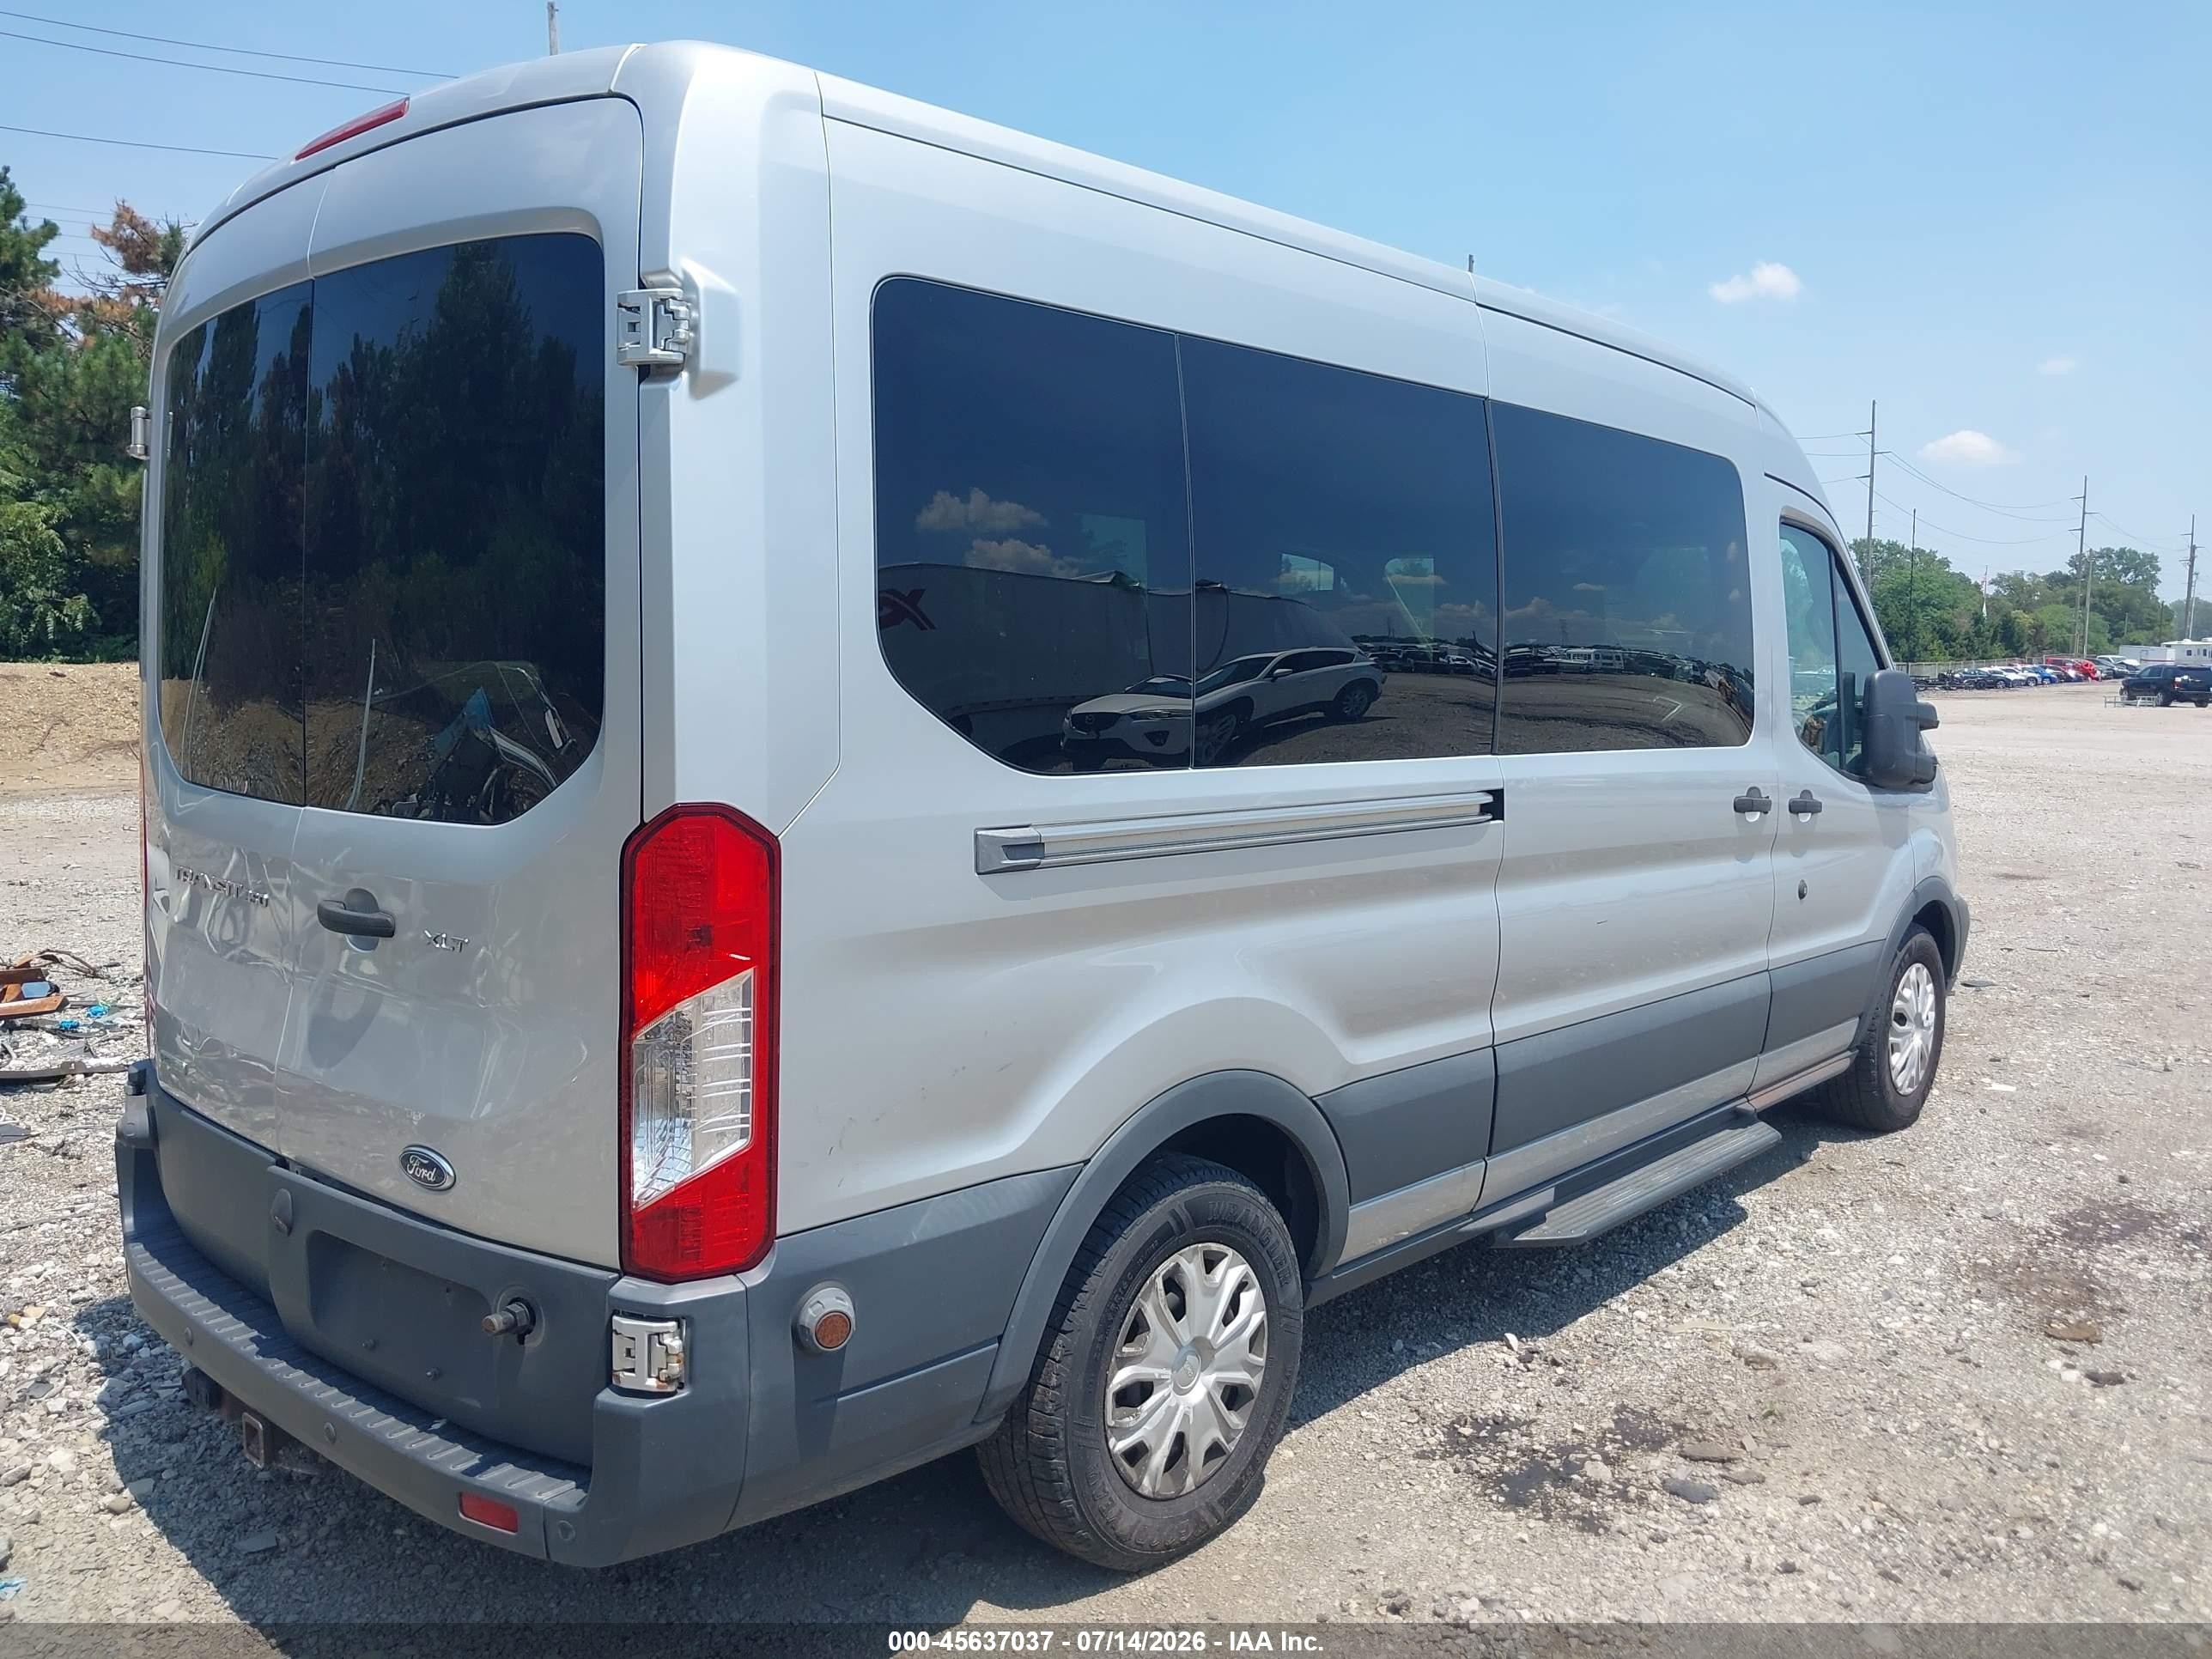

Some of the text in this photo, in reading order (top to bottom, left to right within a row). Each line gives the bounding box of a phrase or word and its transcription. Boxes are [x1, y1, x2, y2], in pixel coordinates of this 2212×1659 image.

[175, 865, 244, 898] TRANSIT
[423, 929, 469, 953] XLT
[406, 1154, 436, 1182] Ford
[1207, 1200, 1291, 1288] WRANGLER
